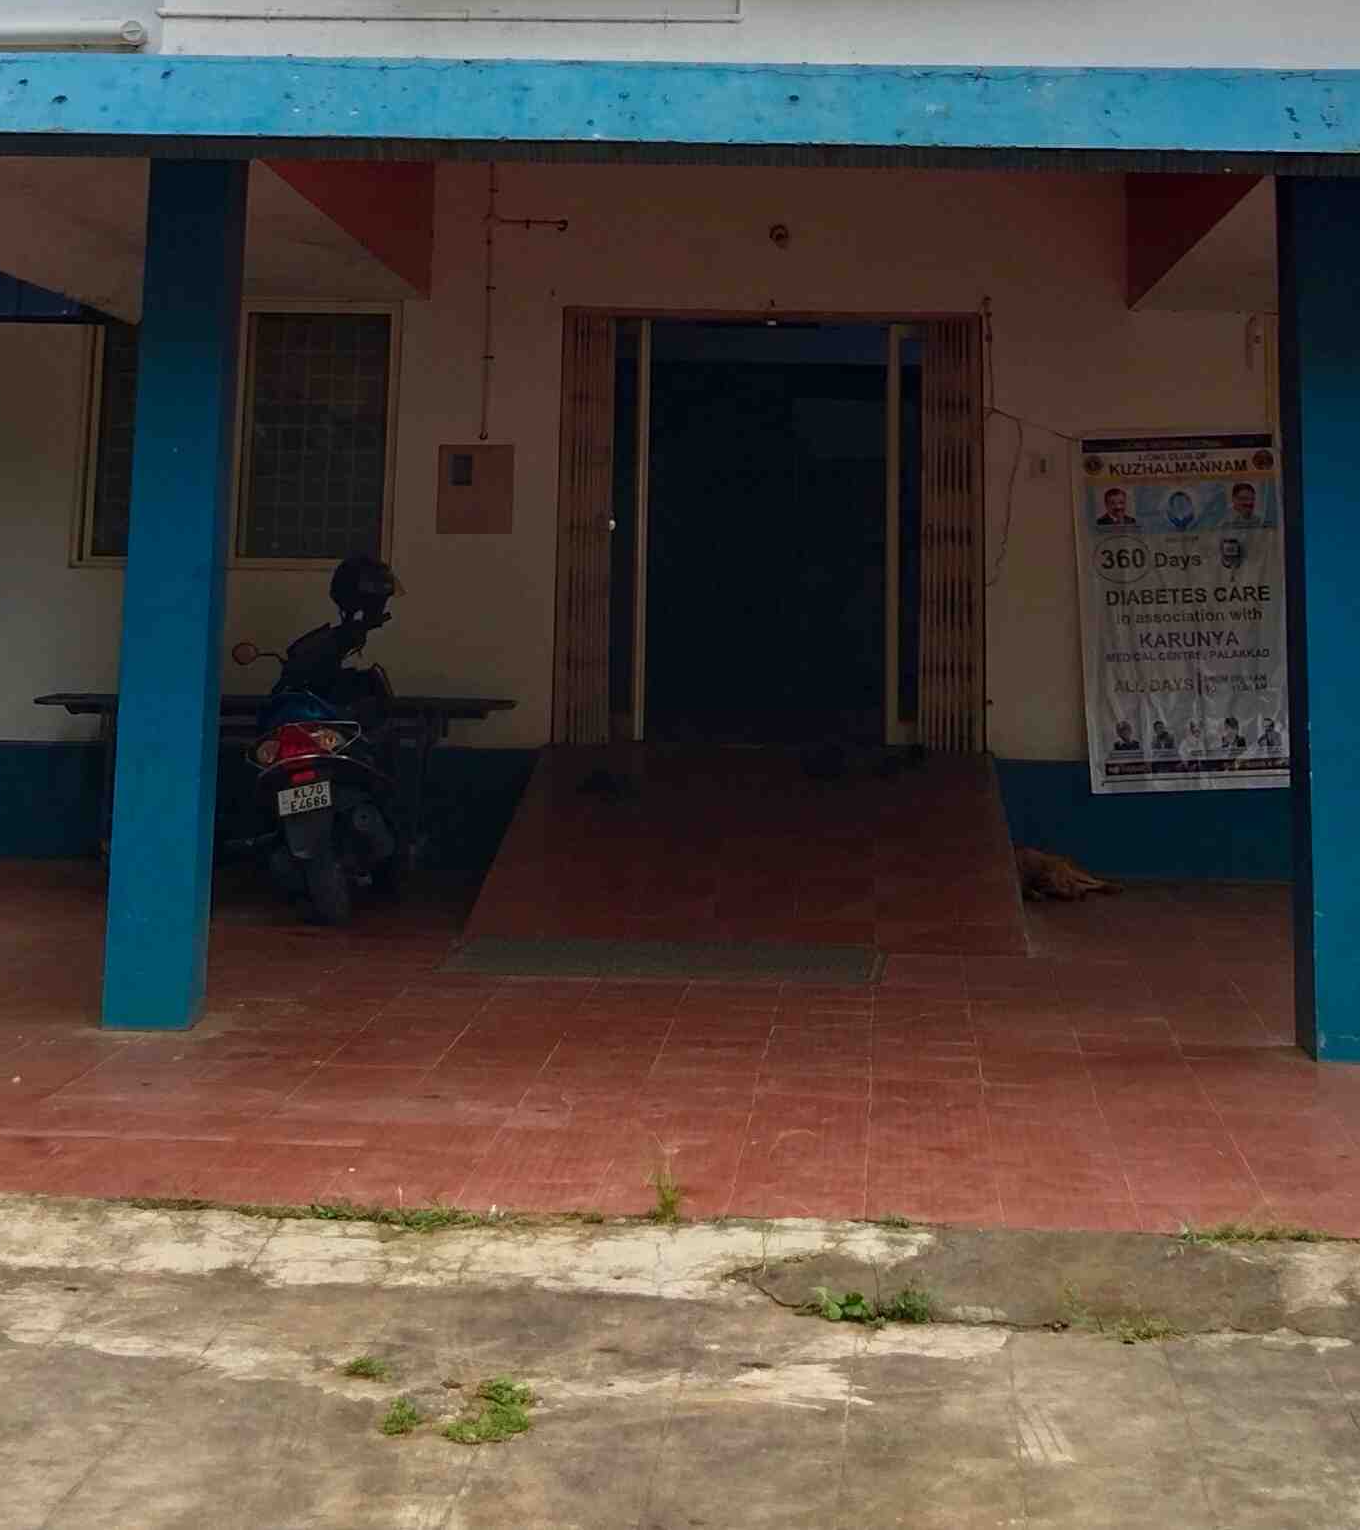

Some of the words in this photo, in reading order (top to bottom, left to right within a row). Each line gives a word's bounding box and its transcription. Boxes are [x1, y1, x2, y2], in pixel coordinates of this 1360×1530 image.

[1108, 459, 1248, 476] KUZHALMANNAM
[1101, 548, 1145, 570] 360
[1154, 552, 1202, 570] Days
[1105, 587, 1207, 606] DIABETES
[1214, 584, 1272, 602] CARE
[1229, 607, 1263, 621] with
[1139, 630, 1240, 648] KARUNYA
